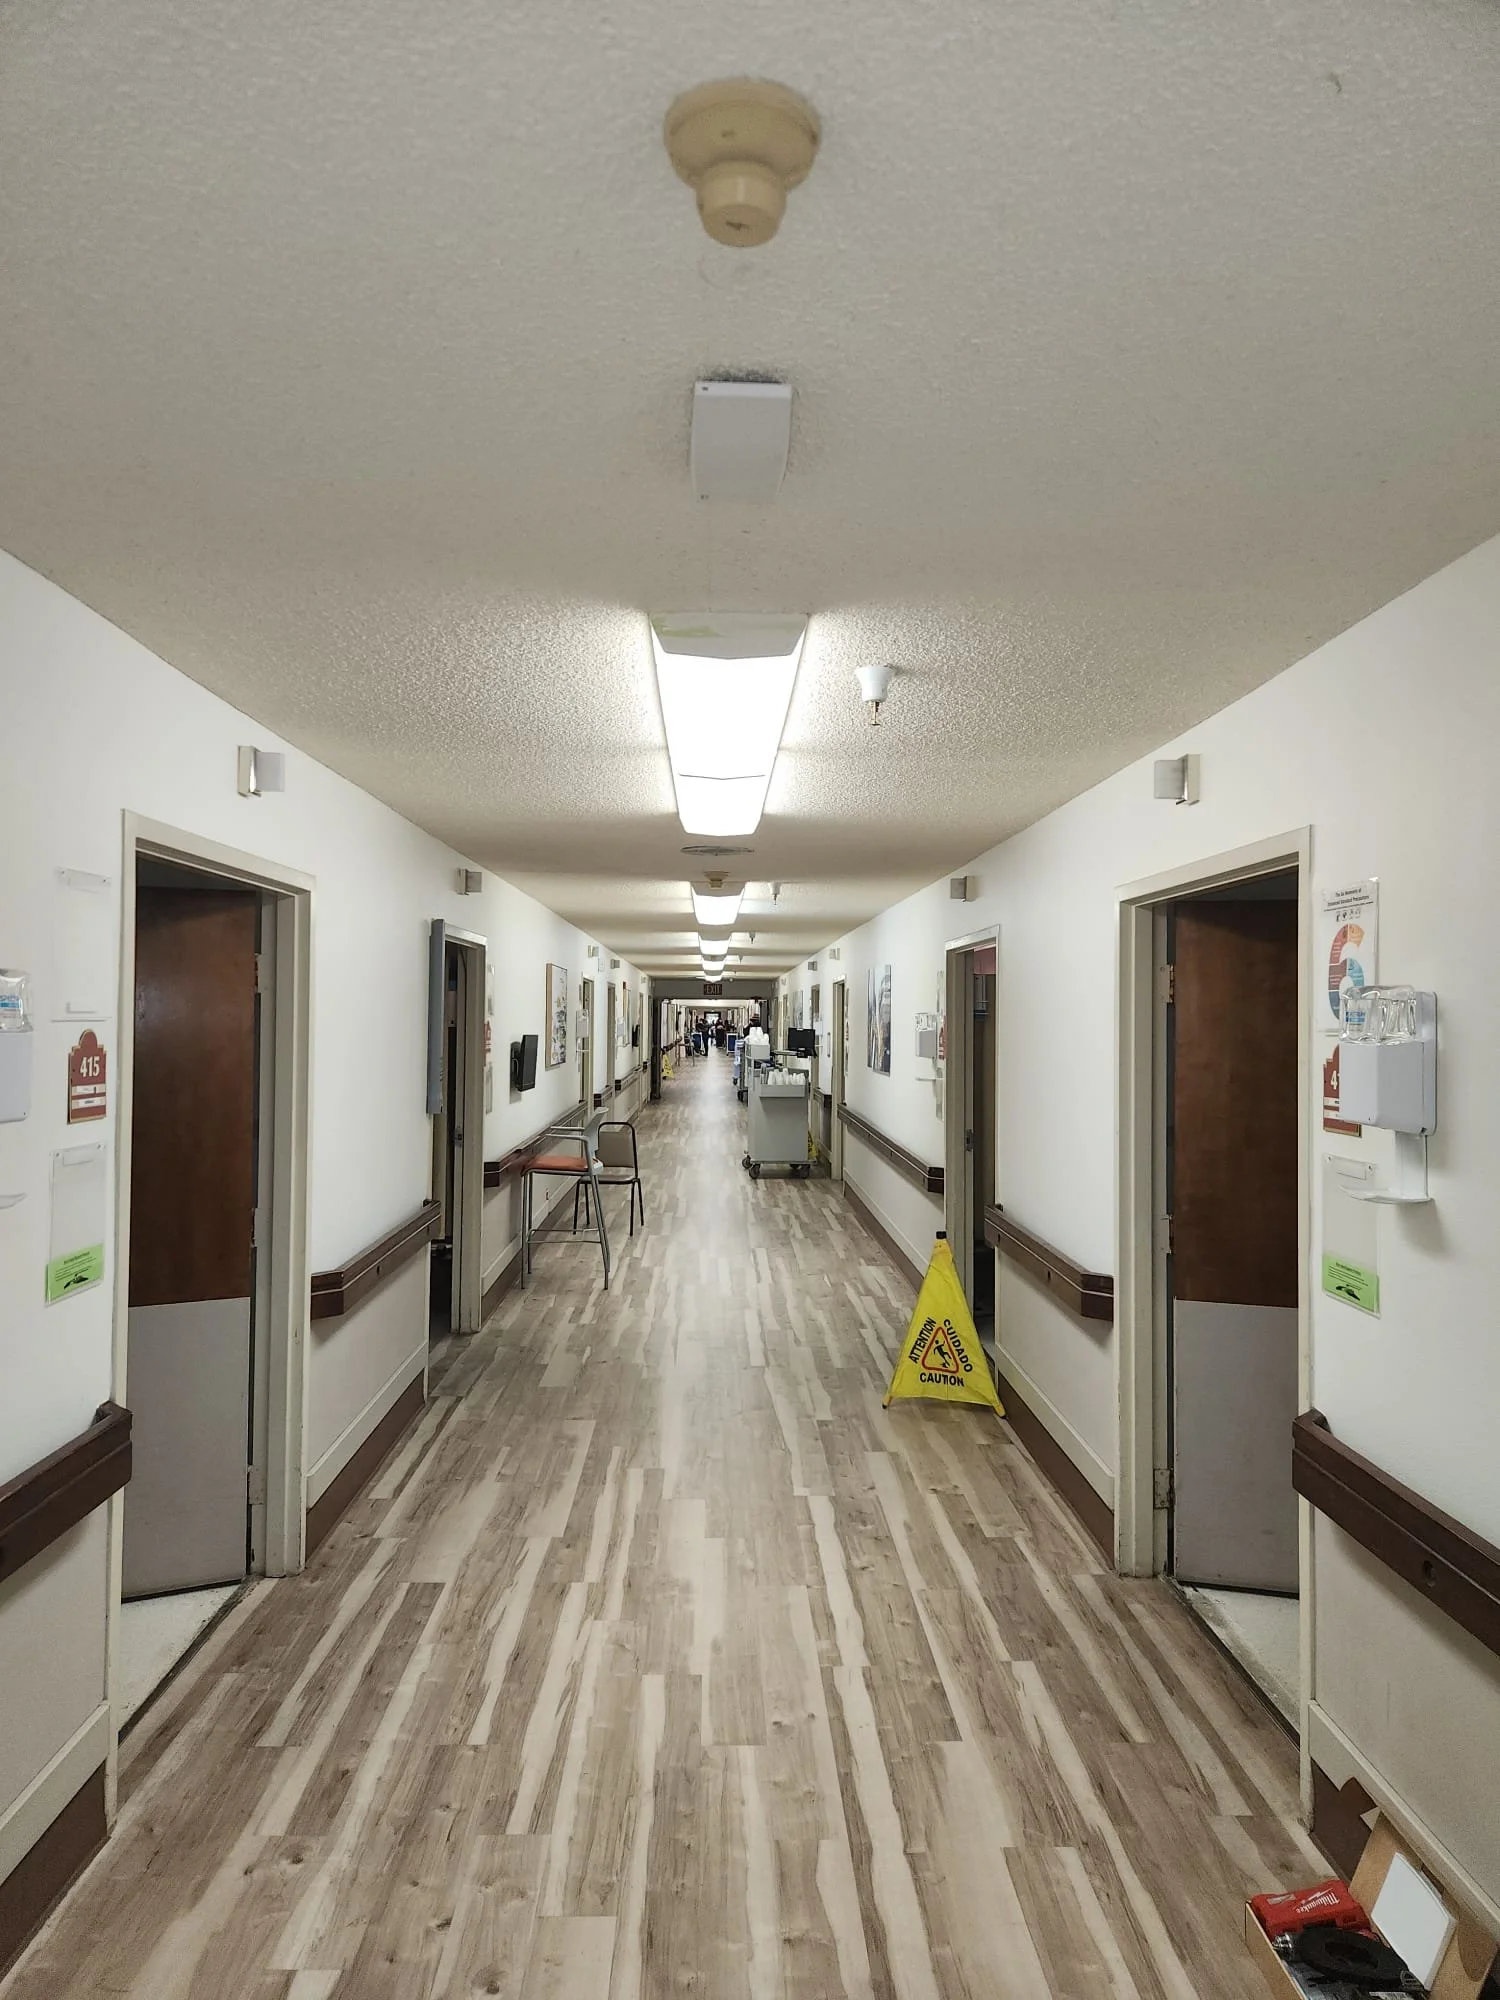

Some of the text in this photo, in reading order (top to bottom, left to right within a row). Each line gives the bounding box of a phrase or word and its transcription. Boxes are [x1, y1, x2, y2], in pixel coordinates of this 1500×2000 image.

[706, 984, 721, 994] EXIT
[80, 1055, 100, 1077] 415
[1330, 1070, 1340, 1090] 4
[909, 1317, 937, 1364] ATTENTION
[943, 1319, 973, 1372] CUIDADO
[919, 1372, 964, 1387] CAUTION
